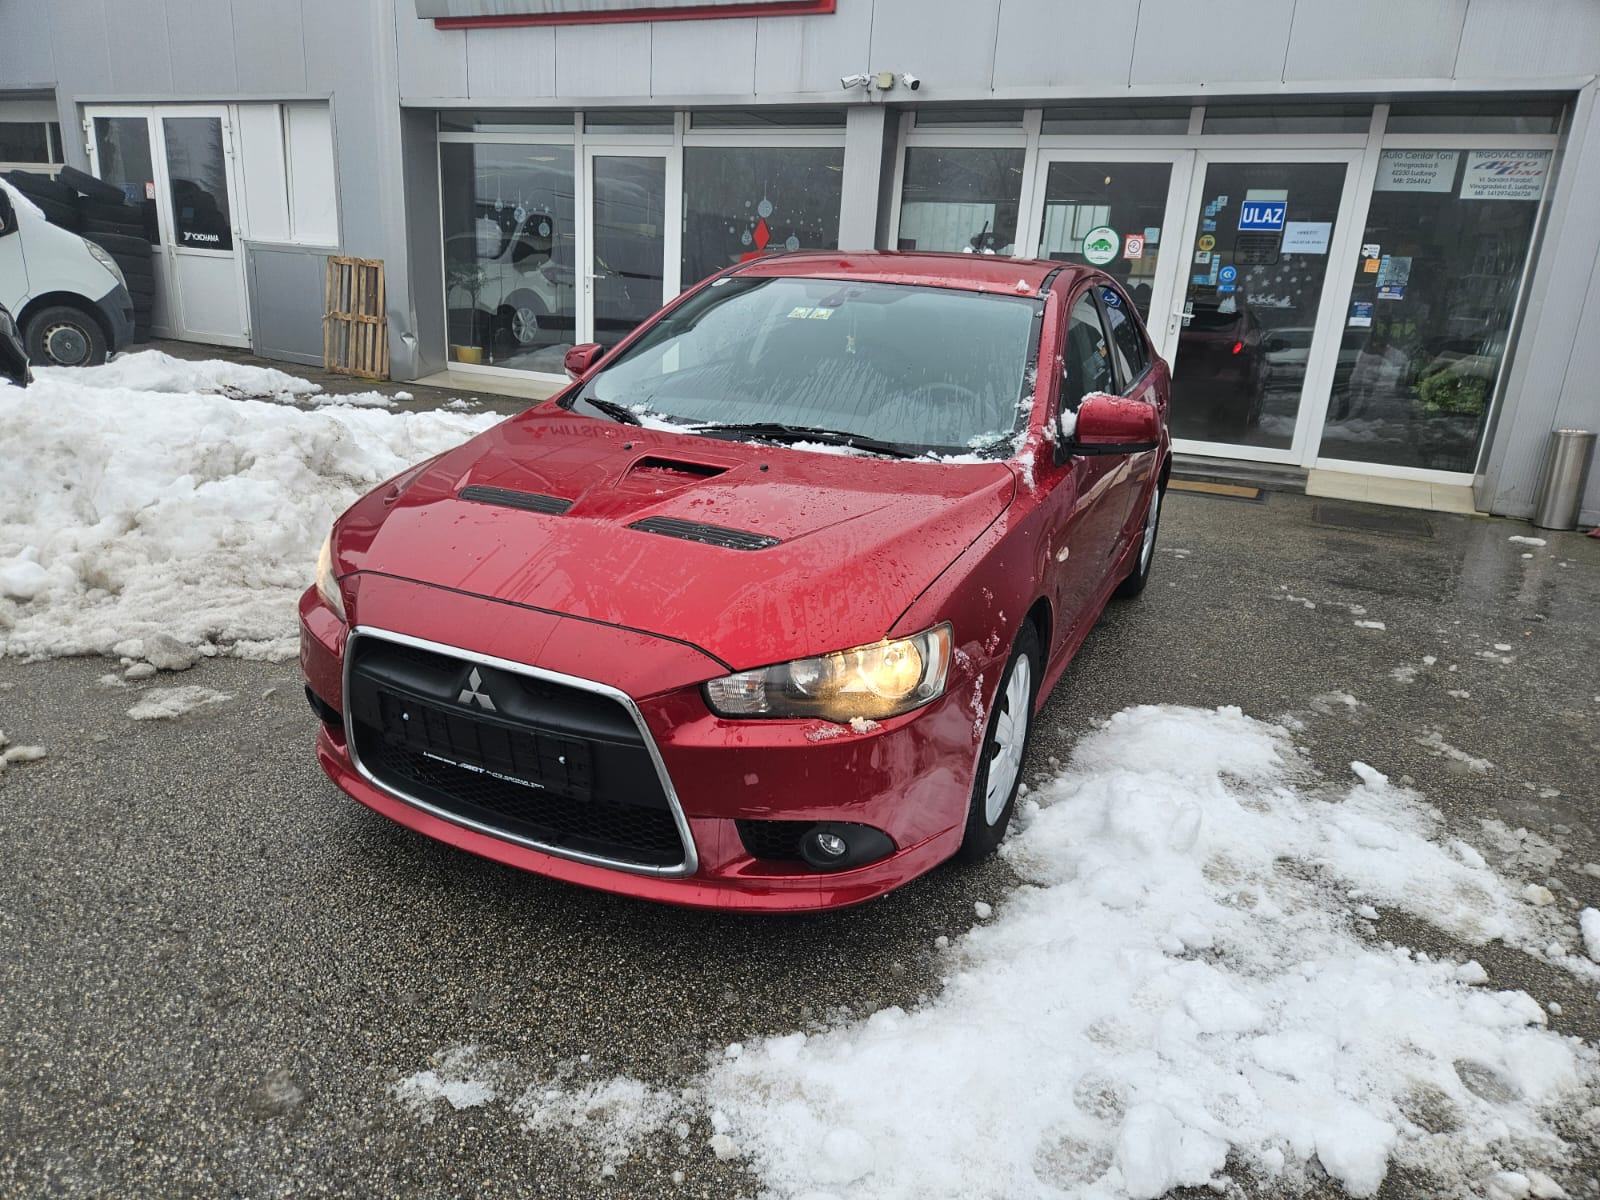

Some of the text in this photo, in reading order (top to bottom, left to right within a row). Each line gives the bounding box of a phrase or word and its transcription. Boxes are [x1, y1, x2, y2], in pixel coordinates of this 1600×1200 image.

[1383, 151, 1403, 159] Auto
[1242, 207, 1283, 223] ULAZ
[192, 233, 220, 242] YOKOHAMA
